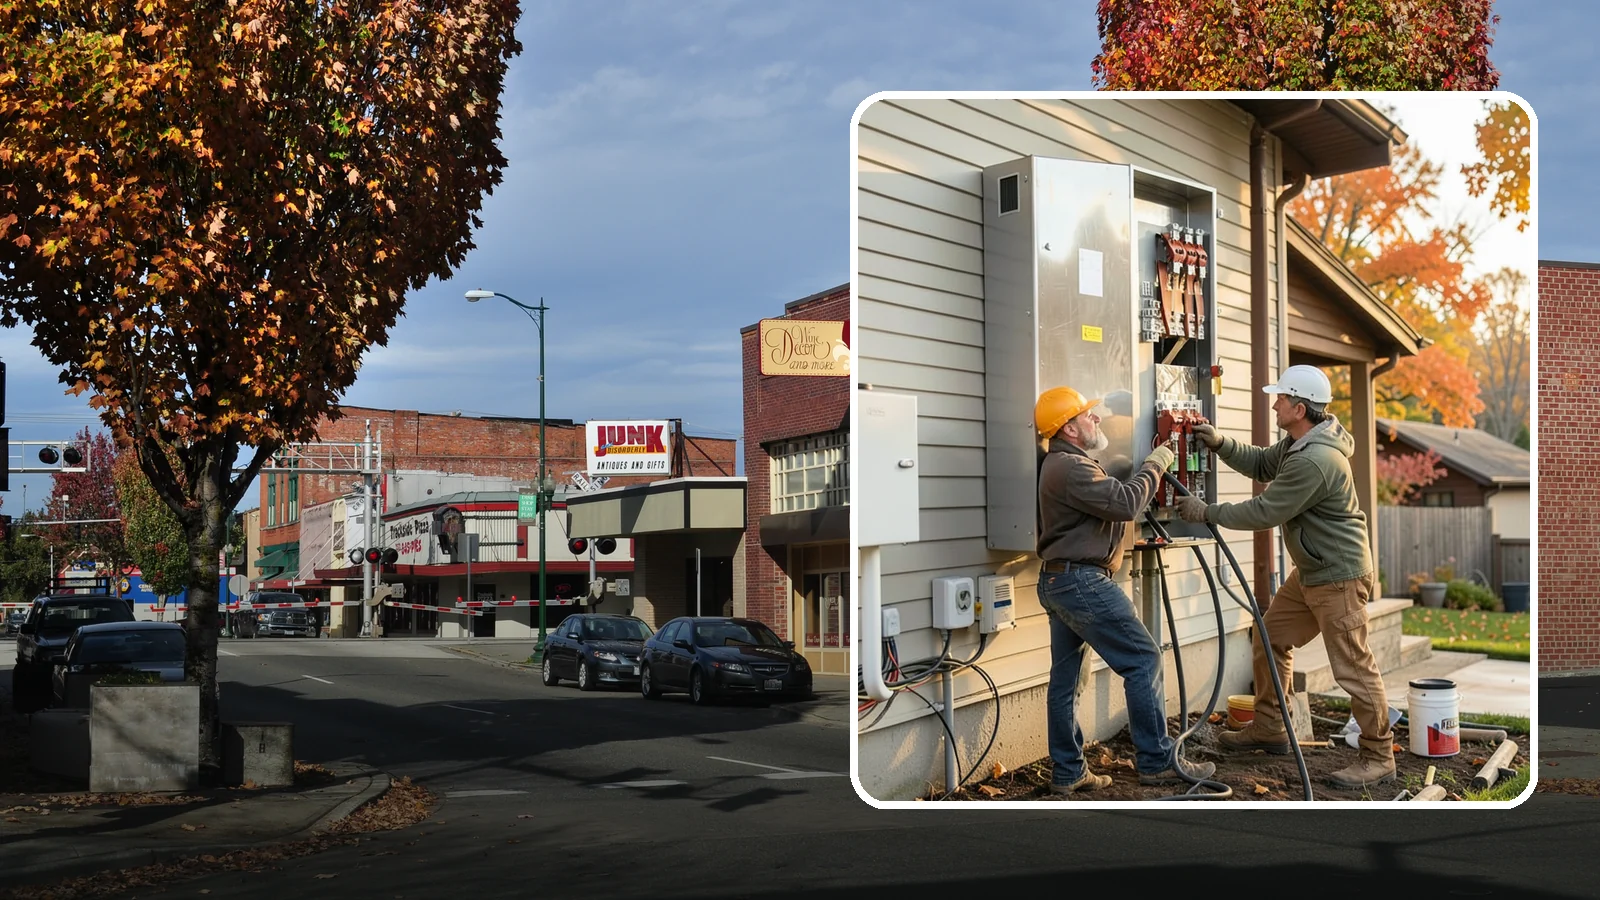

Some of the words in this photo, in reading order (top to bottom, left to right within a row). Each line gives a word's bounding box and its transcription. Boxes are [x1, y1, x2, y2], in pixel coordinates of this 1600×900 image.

[595, 425, 665, 457] JUNK
[607, 446, 645, 454] DISORDERLY
[597, 461, 628, 470] ANTIQUES
[631, 461, 643, 470] AND
[647, 460, 665, 470] GIFTS
[390, 521, 413, 540] Trackside
[414, 519, 429, 535] Pizza
